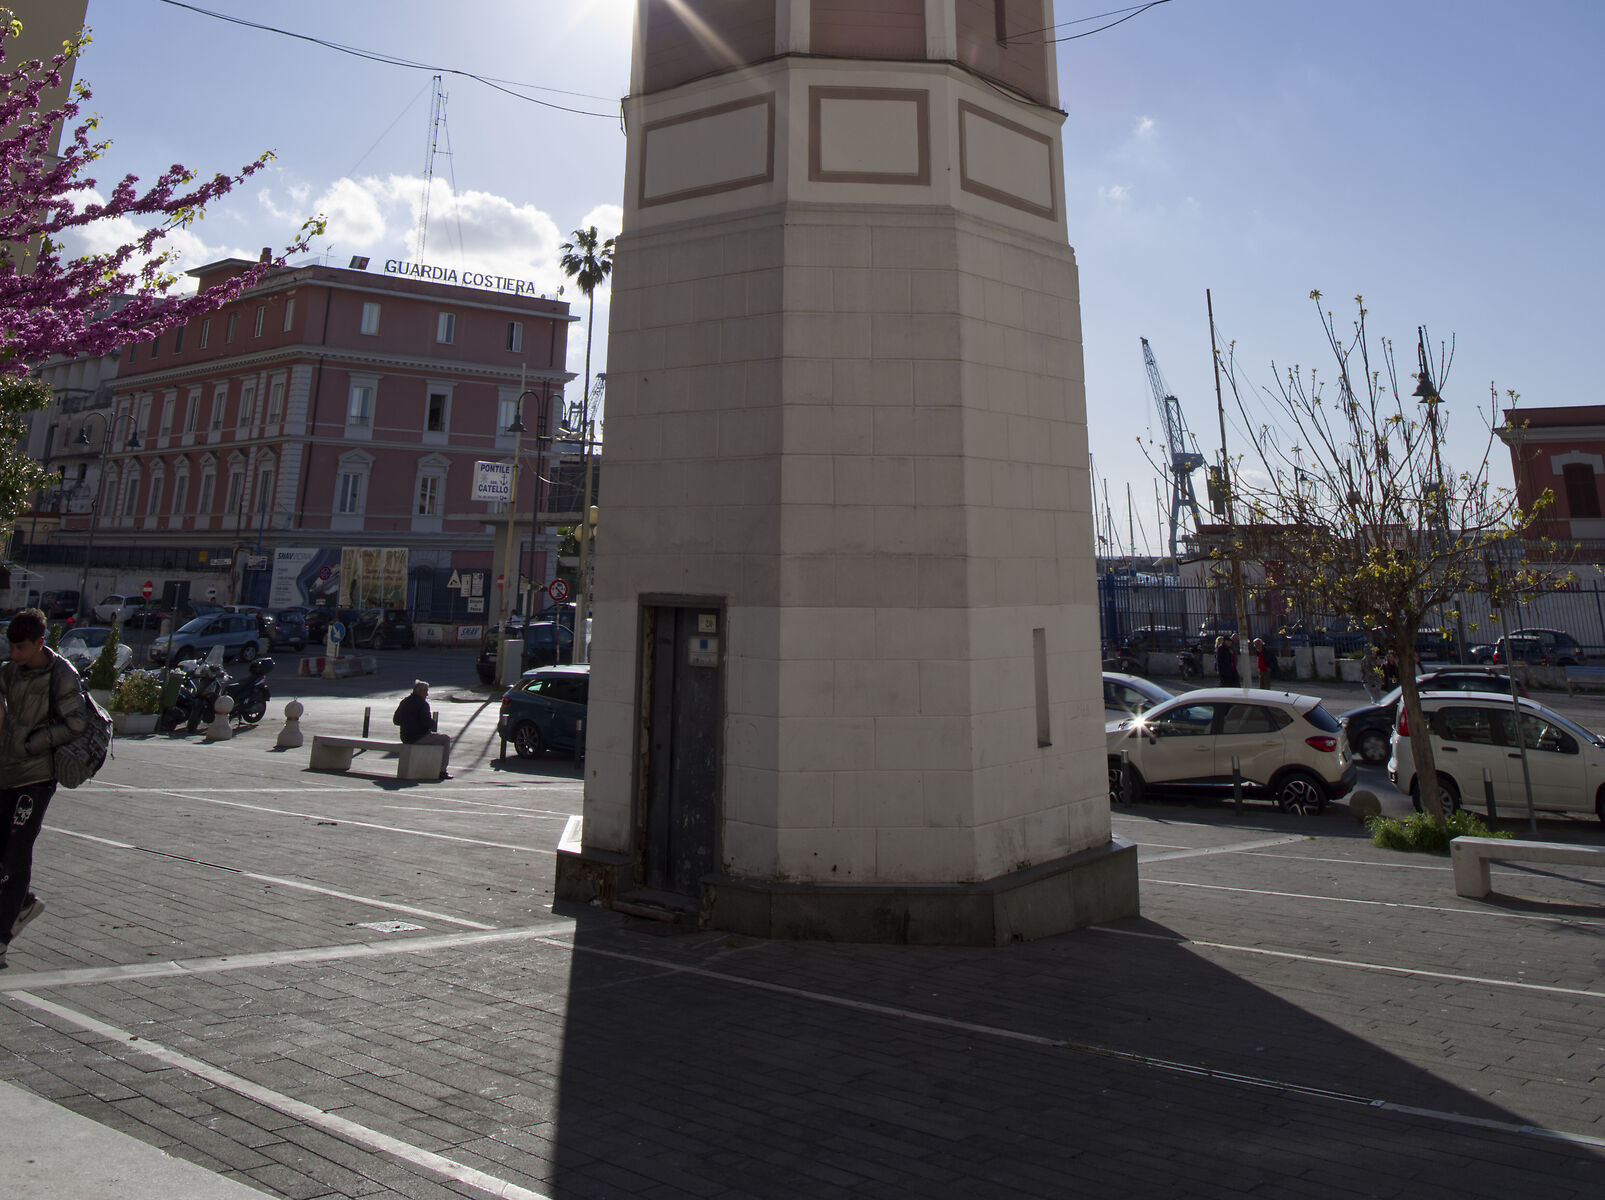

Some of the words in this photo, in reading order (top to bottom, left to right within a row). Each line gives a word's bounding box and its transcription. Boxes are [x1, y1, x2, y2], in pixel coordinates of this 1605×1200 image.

[385, 259, 458, 282] GUARDIA
[462, 271, 535, 294] COSTIERA
[480, 464, 510, 474] PONTILE
[478, 484, 509, 494] CATELLO
